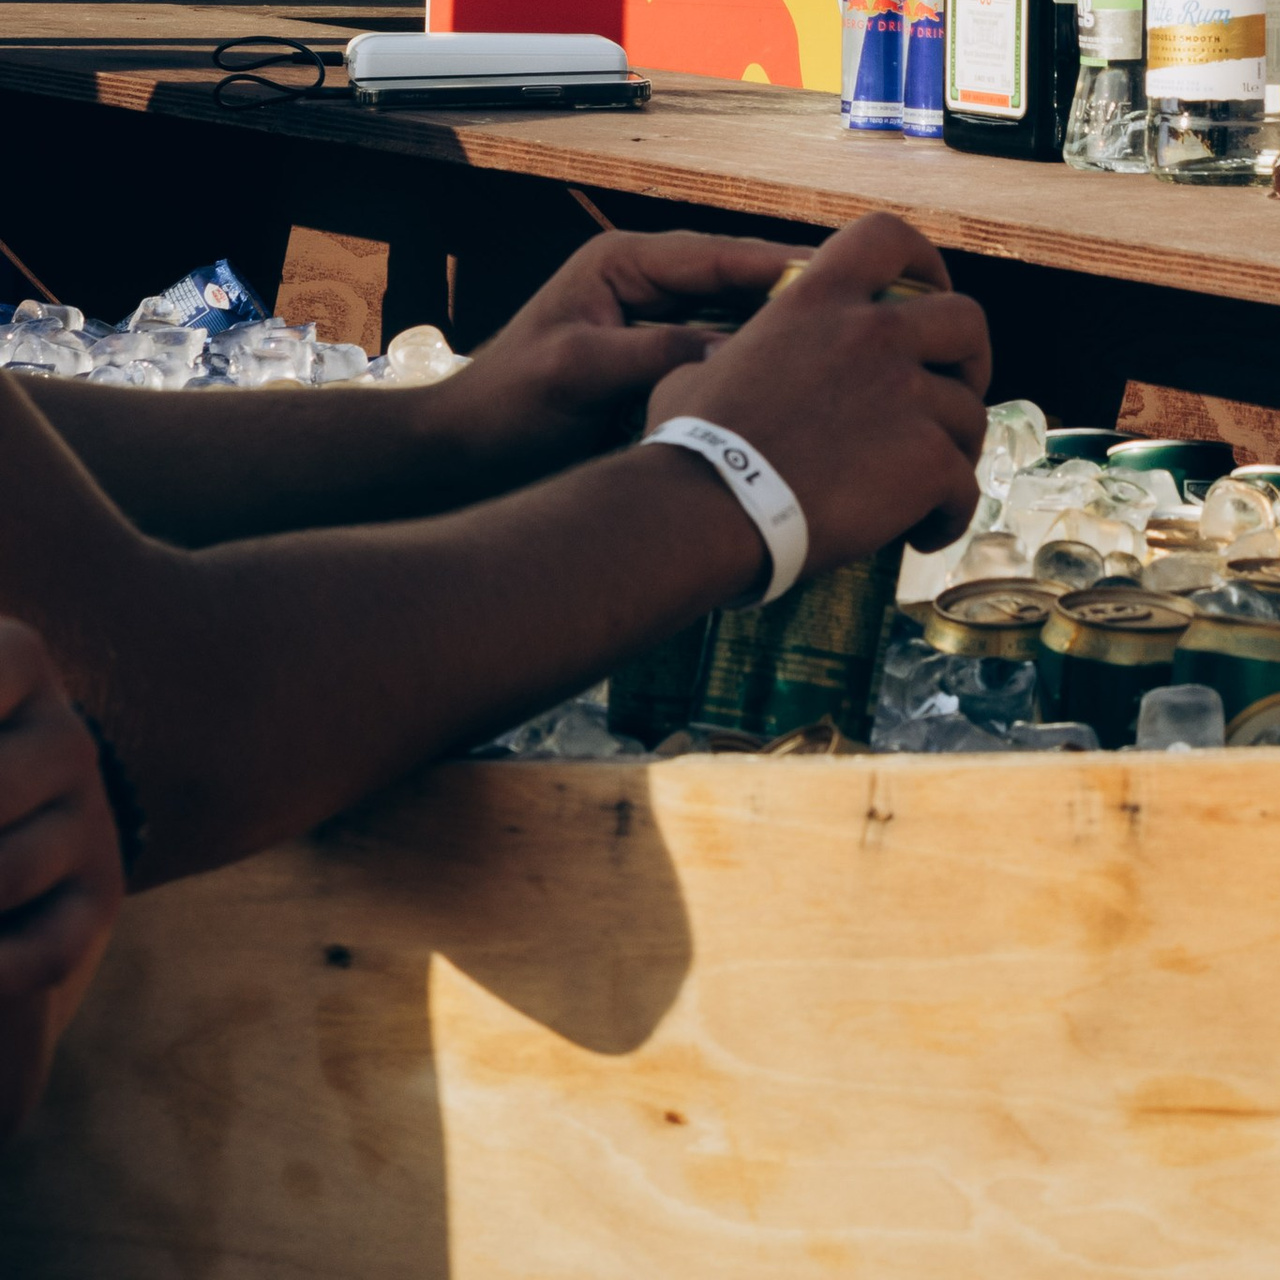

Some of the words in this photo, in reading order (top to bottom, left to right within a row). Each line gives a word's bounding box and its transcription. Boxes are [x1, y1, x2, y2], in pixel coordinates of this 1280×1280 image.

[1152, 0, 1174, 23] hite
[1177, 0, 1232, 28] Rum
[1179, 34, 1221, 43] SMOOTH
